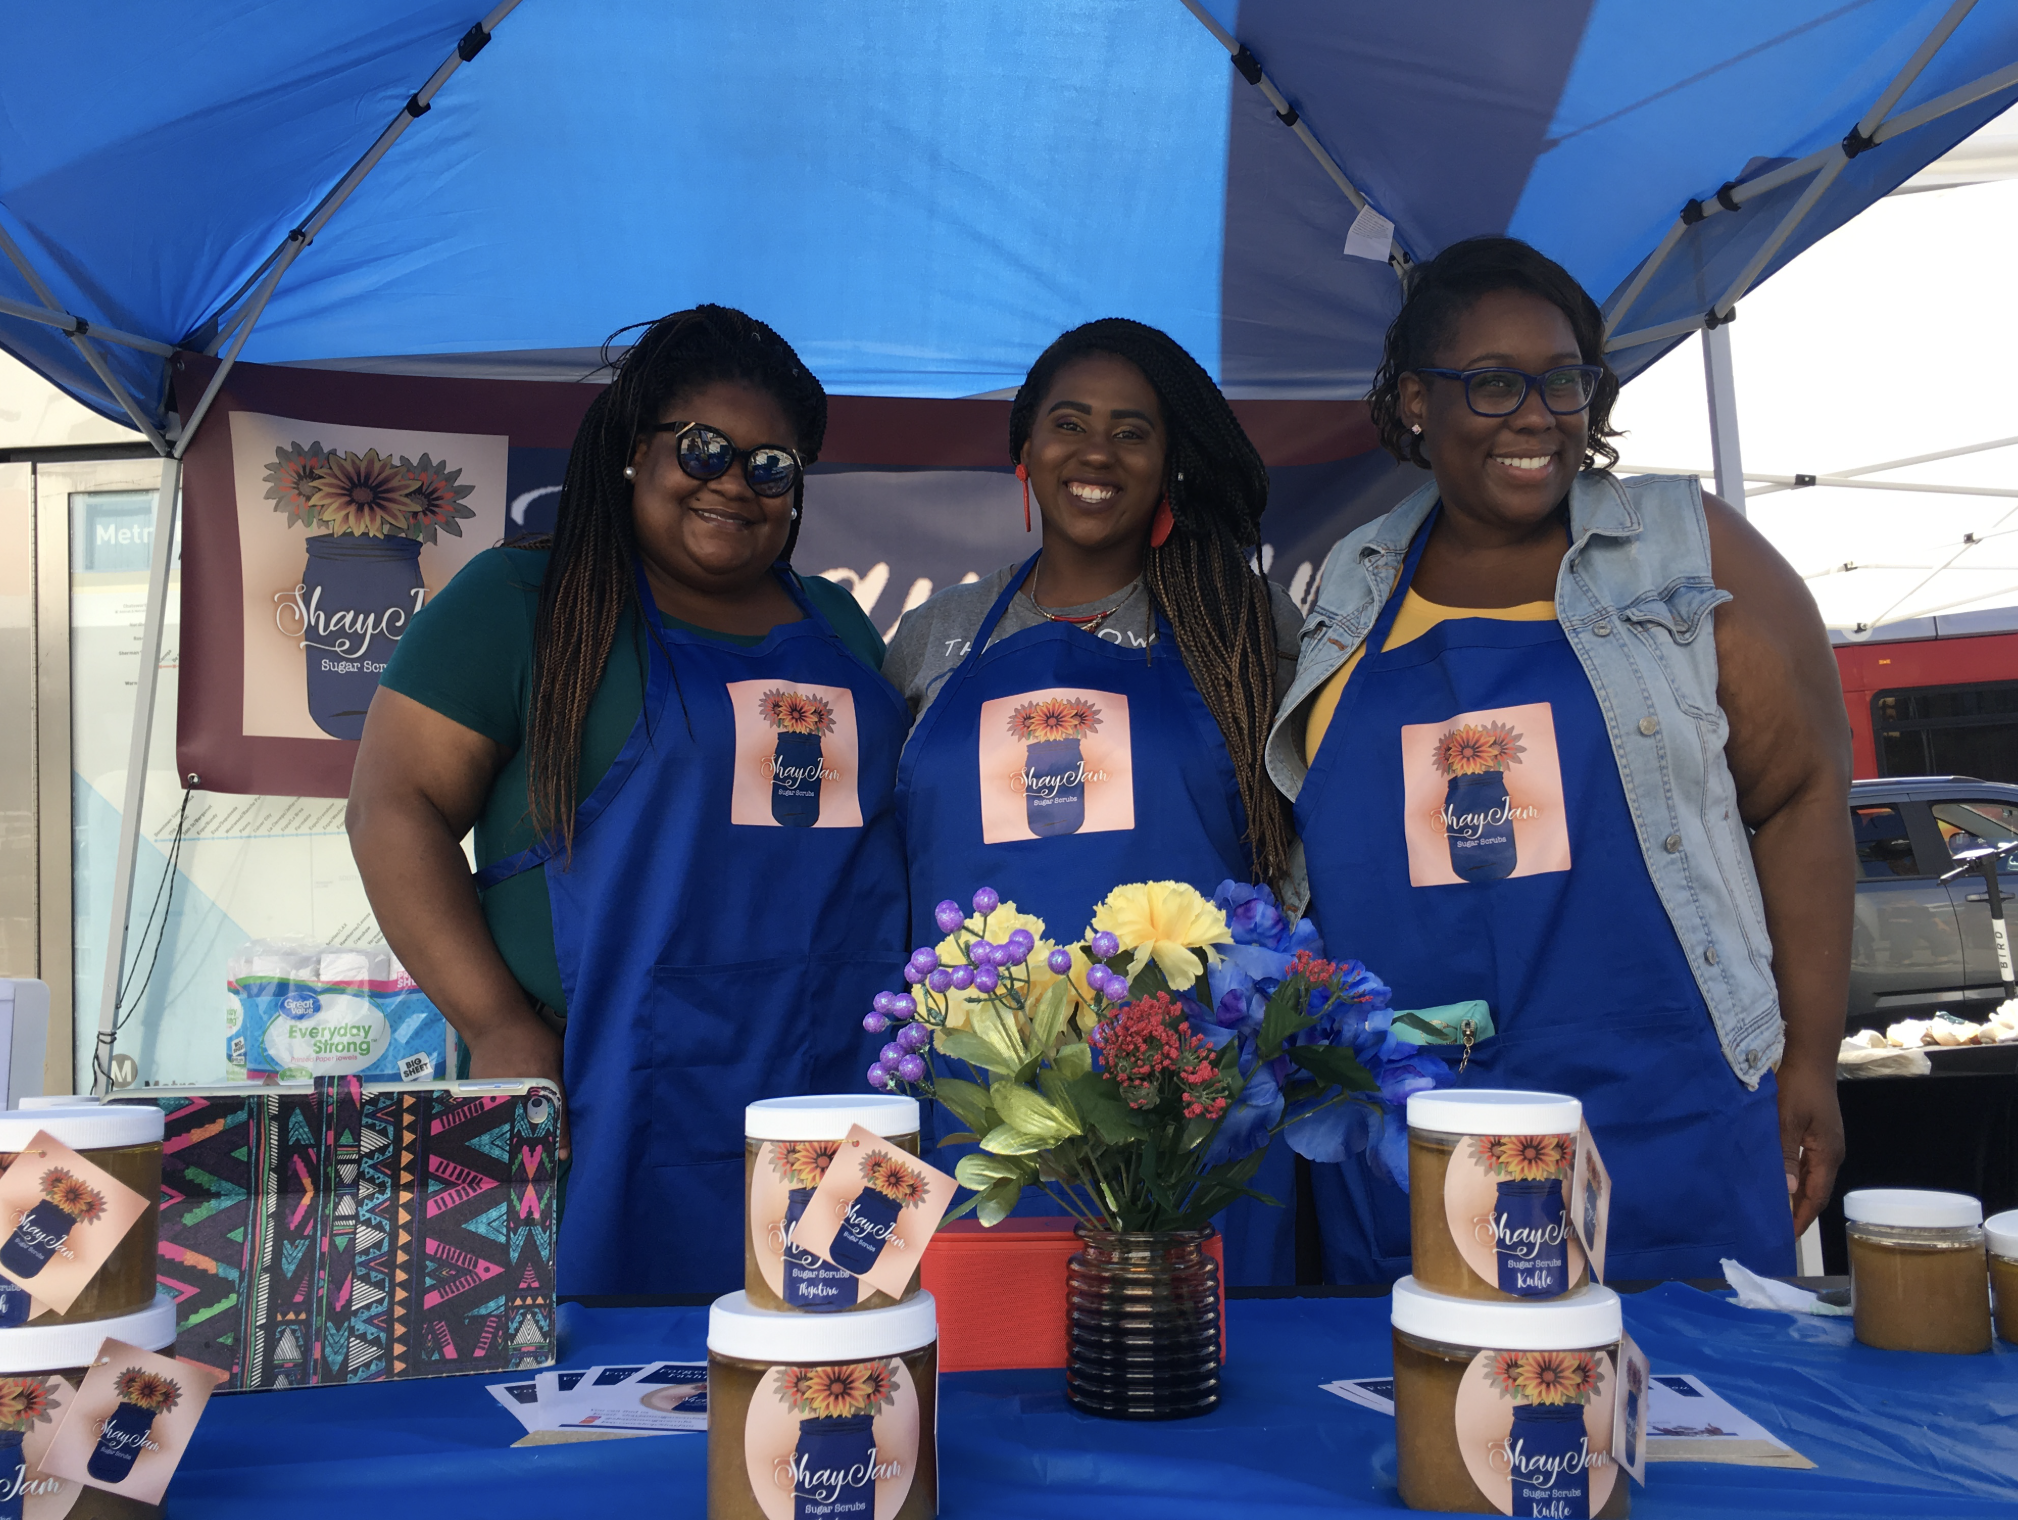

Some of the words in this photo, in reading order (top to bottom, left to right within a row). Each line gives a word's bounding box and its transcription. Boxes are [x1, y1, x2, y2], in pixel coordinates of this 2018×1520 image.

[96, 523, 154, 545] Metr
[274, 583, 430, 658] ShayJ
[321, 658, 360, 674] Sugar
[364, 660, 388, 673] Scr
[760, 753, 842, 789] ShayJam
[1009, 760, 1112, 799] ShayJam
[778, 788, 796, 797] Sugar
[796, 789, 815, 797] Scrubs
[1033, 798, 1053, 807] Sugar
[1054, 796, 1078, 804] Scrubs
[1430, 795, 1542, 839] ShayJam
[1456, 839, 1479, 848] Sugar
[1480, 836, 1507, 846] Scrubs
[1995, 931, 2009, 969] BIRD
[284, 998, 314, 1009] Great
[290, 1006, 314, 1015] Value
[288, 1022, 372, 1042] Everyday
[312, 1038, 371, 1056] Strong
[315, 1055, 334, 1063] Paper
[336, 1054, 358, 1062] Towels
[405, 1057, 422, 1069] BIG
[403, 1063, 429, 1078] SHEET
[9, 1207, 76, 1262] ShayJam
[835, 1198, 908, 1251] ShayJam
[843, 1230, 859, 1244] Sugar
[858, 1239, 876, 1253] Scrubs
[792, 1268, 818, 1279] Sugar
[818, 1268, 850, 1279] Scrubs
[1508, 1259, 1534, 1270] Sugar
[1535, 1258, 1562, 1268] Scrubs
[1517, 1269, 1554, 1289] Kuhle
[93, 1416, 161, 1452] ShayJam
[1487, 1436, 1611, 1489] ShayJam
[774, 1447, 903, 1504] ShayJam
[1522, 1488, 1550, 1500] Sugar
[1551, 1488, 1581, 1498] Scrubs
[804, 1504, 833, 1516] Sugar
[834, 1502, 866, 1513] Scrubs
[1532, 1500, 1572, 1520] Kuhle
